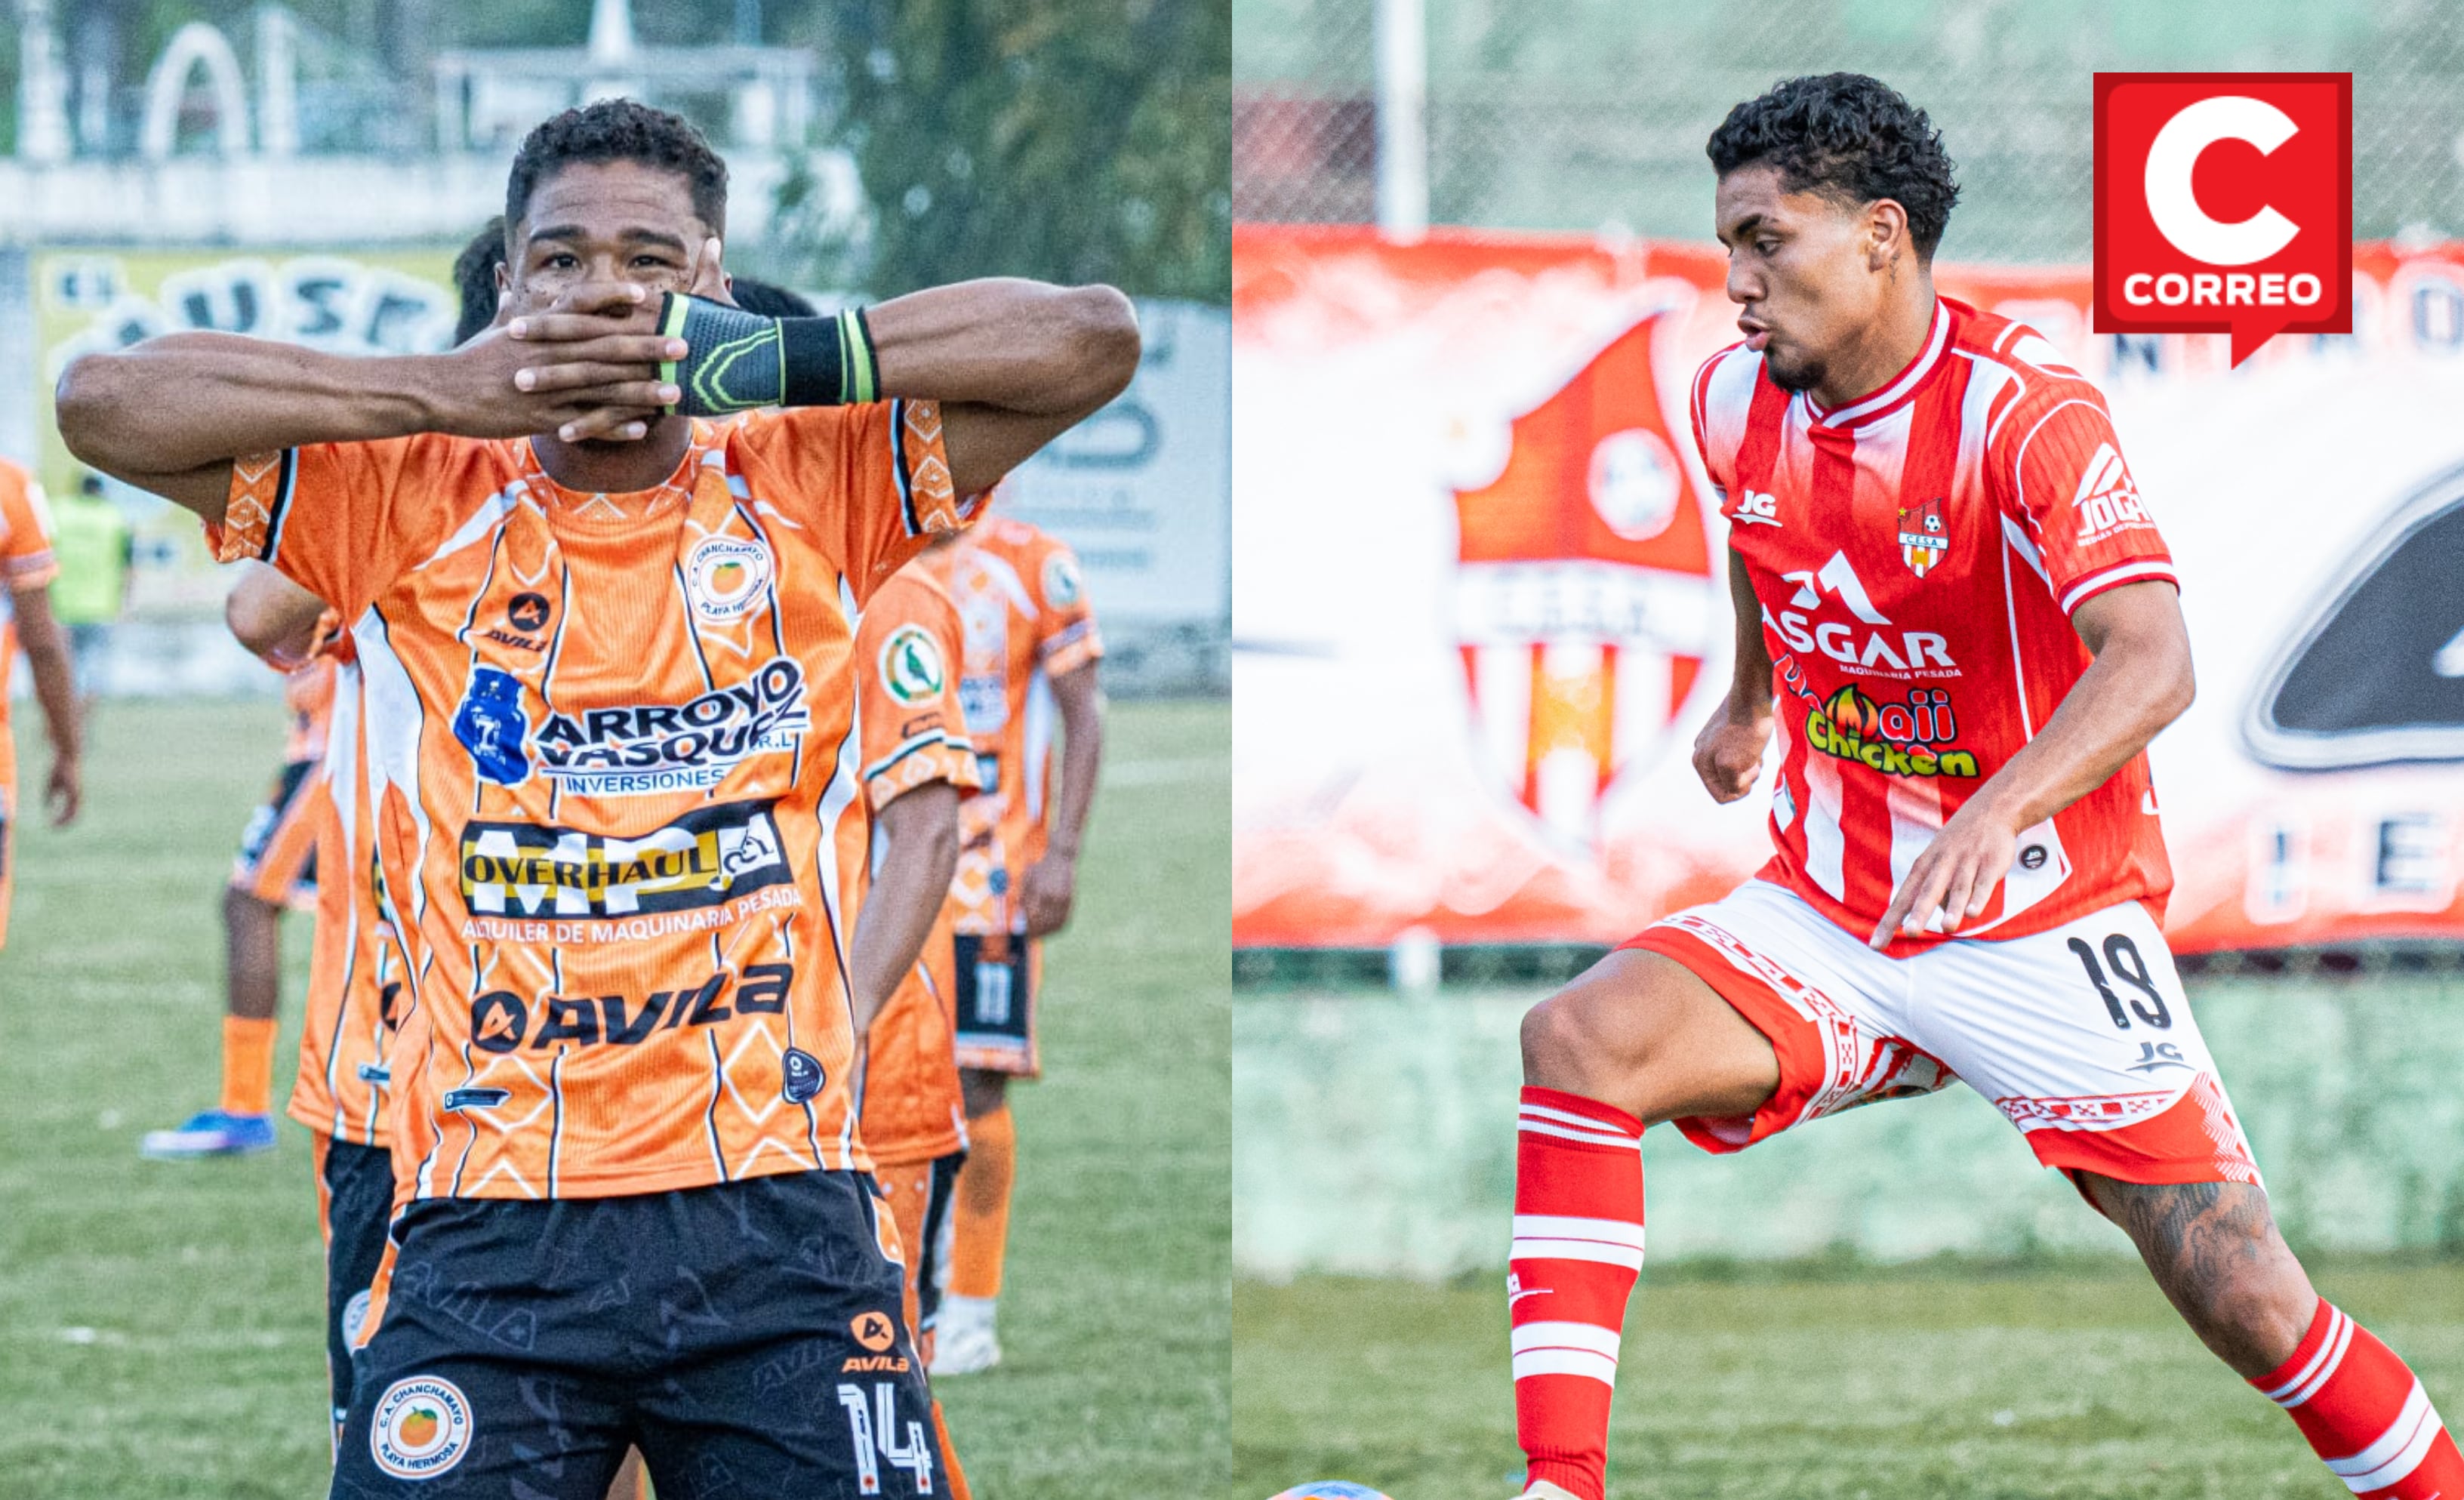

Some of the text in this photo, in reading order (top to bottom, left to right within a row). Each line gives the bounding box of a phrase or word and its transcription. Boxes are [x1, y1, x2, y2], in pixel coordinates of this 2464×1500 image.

[1736, 489, 1776, 517] JG
[2078, 489, 2152, 537] JOGA
[1914, 668, 1963, 678] PESADA
[537, 661, 799, 746] ARROYO
[567, 768, 725, 793] INVERSIONES
[464, 846, 718, 889] OVERHAUL
[556, 923, 584, 943] DE
[591, 908, 735, 944] MAQUINARIA
[738, 888, 802, 919] PESADA
[2067, 933, 2172, 1030] 19
[2136, 1040, 2184, 1063] JG
[393, 1384, 464, 1425] CHANCHAMAYO
[380, 1441, 459, 1469] PLAYA HERMOSA
[836, 1382, 934, 1495] 14
